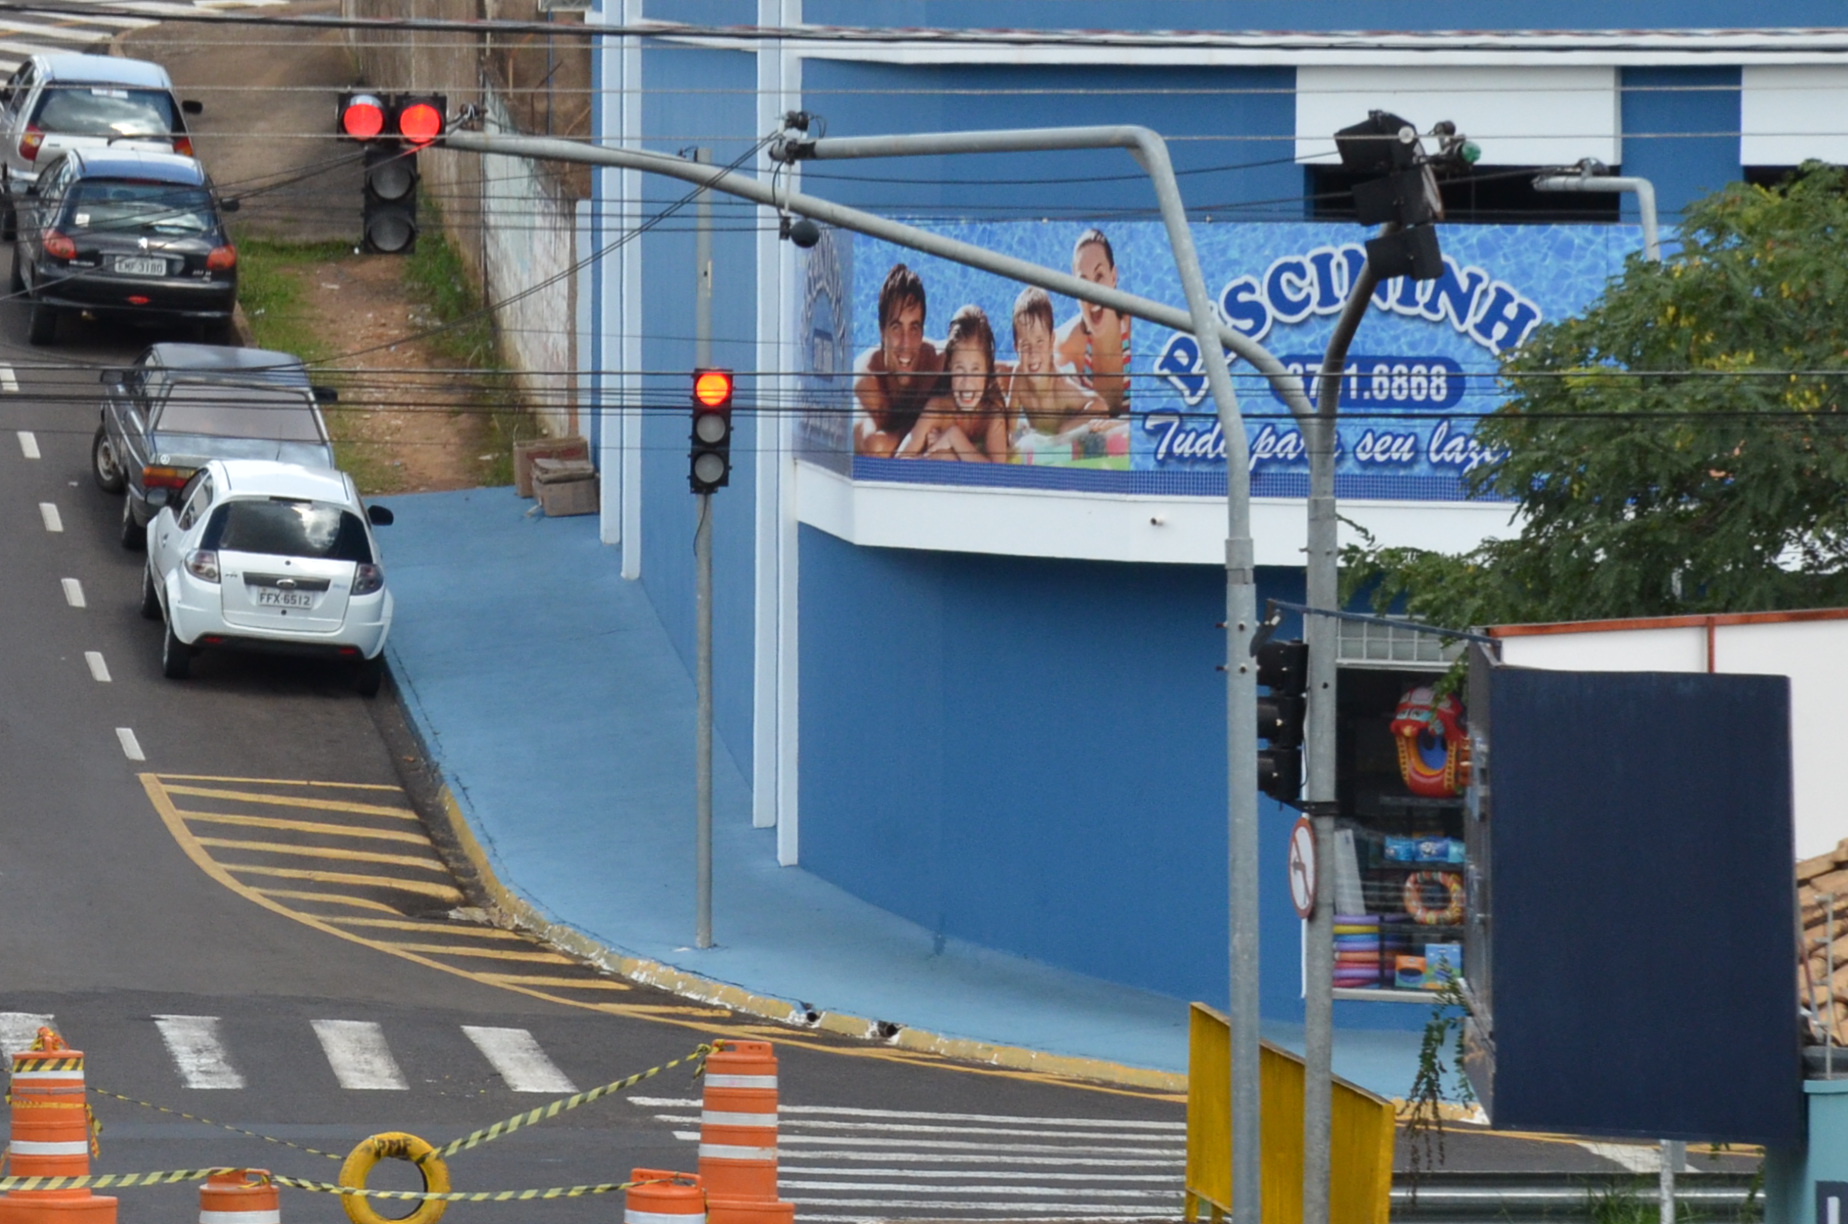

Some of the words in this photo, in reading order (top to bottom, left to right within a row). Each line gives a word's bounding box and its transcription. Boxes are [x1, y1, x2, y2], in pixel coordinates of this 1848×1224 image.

[1154, 243, 1544, 405] PSCINH
[1286, 362, 1448, 402] 71.6868
[1145, 413, 1232, 461] Tud
[1248, 425, 1343, 472] pa
[1355, 431, 1416, 462] seu
[1429, 419, 1513, 475] laz
